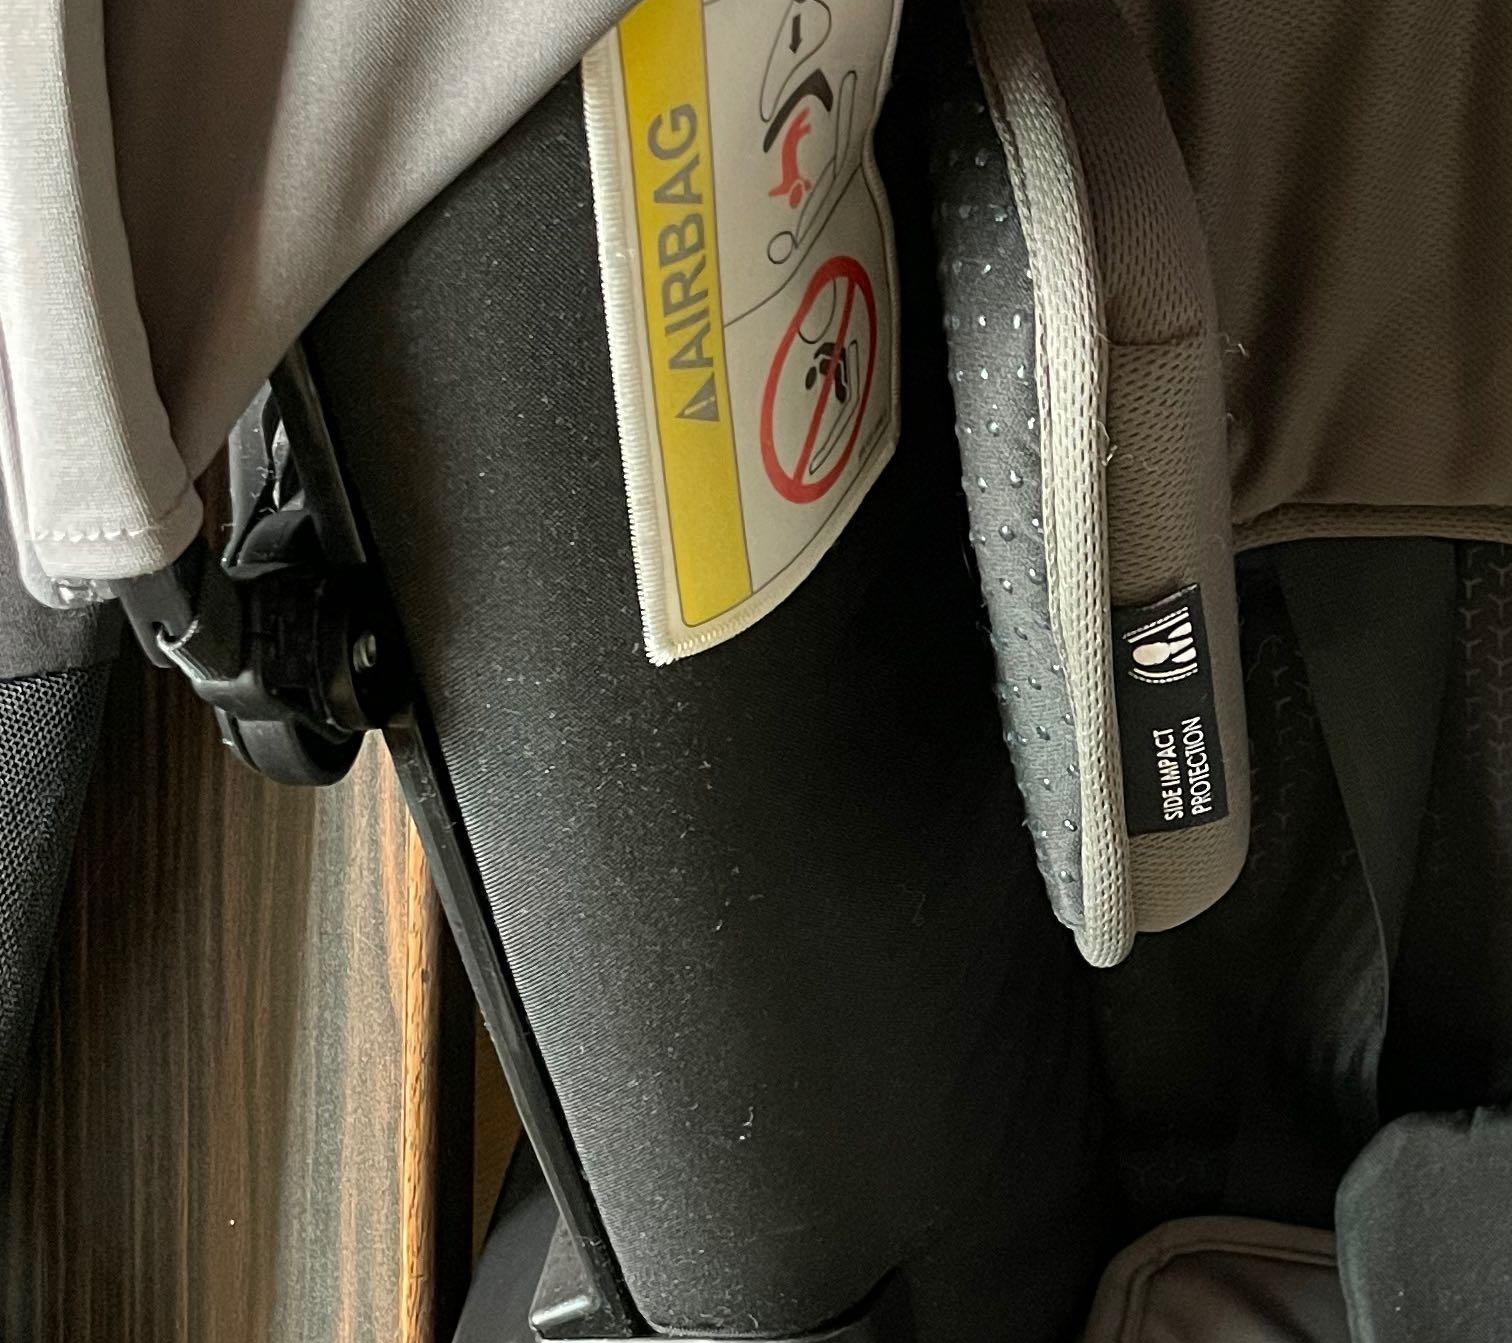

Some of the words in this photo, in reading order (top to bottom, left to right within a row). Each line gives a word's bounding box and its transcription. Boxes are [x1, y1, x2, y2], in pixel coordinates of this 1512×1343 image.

[647, 103, 713, 372] AIRBAG
[1153, 729, 1180, 786] IMPACT
[1181, 716, 1212, 815] PROTECTION
[1162, 788, 1184, 820] SIDE
